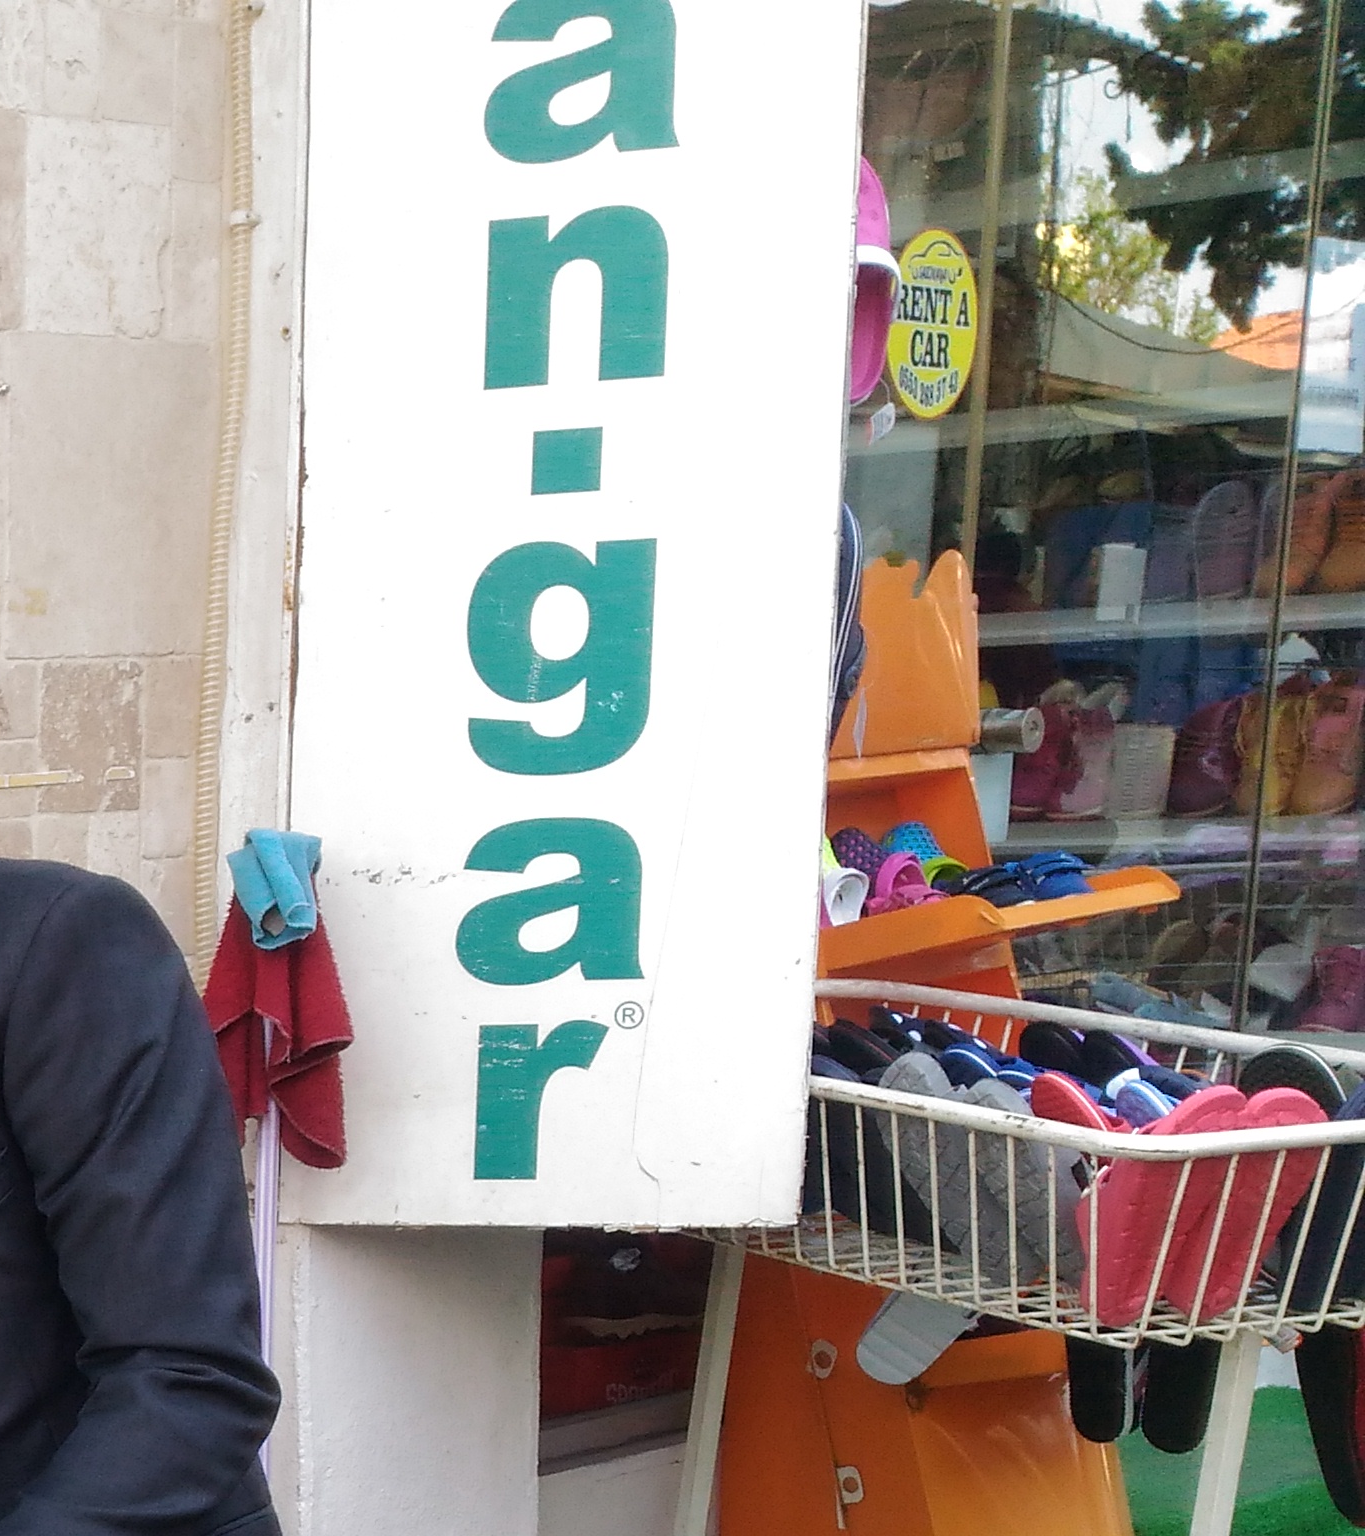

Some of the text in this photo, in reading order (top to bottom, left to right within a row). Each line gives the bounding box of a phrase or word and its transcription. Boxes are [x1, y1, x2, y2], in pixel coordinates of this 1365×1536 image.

[897, 284, 970, 328] RENT A
[910, 329, 950, 369] CAR
